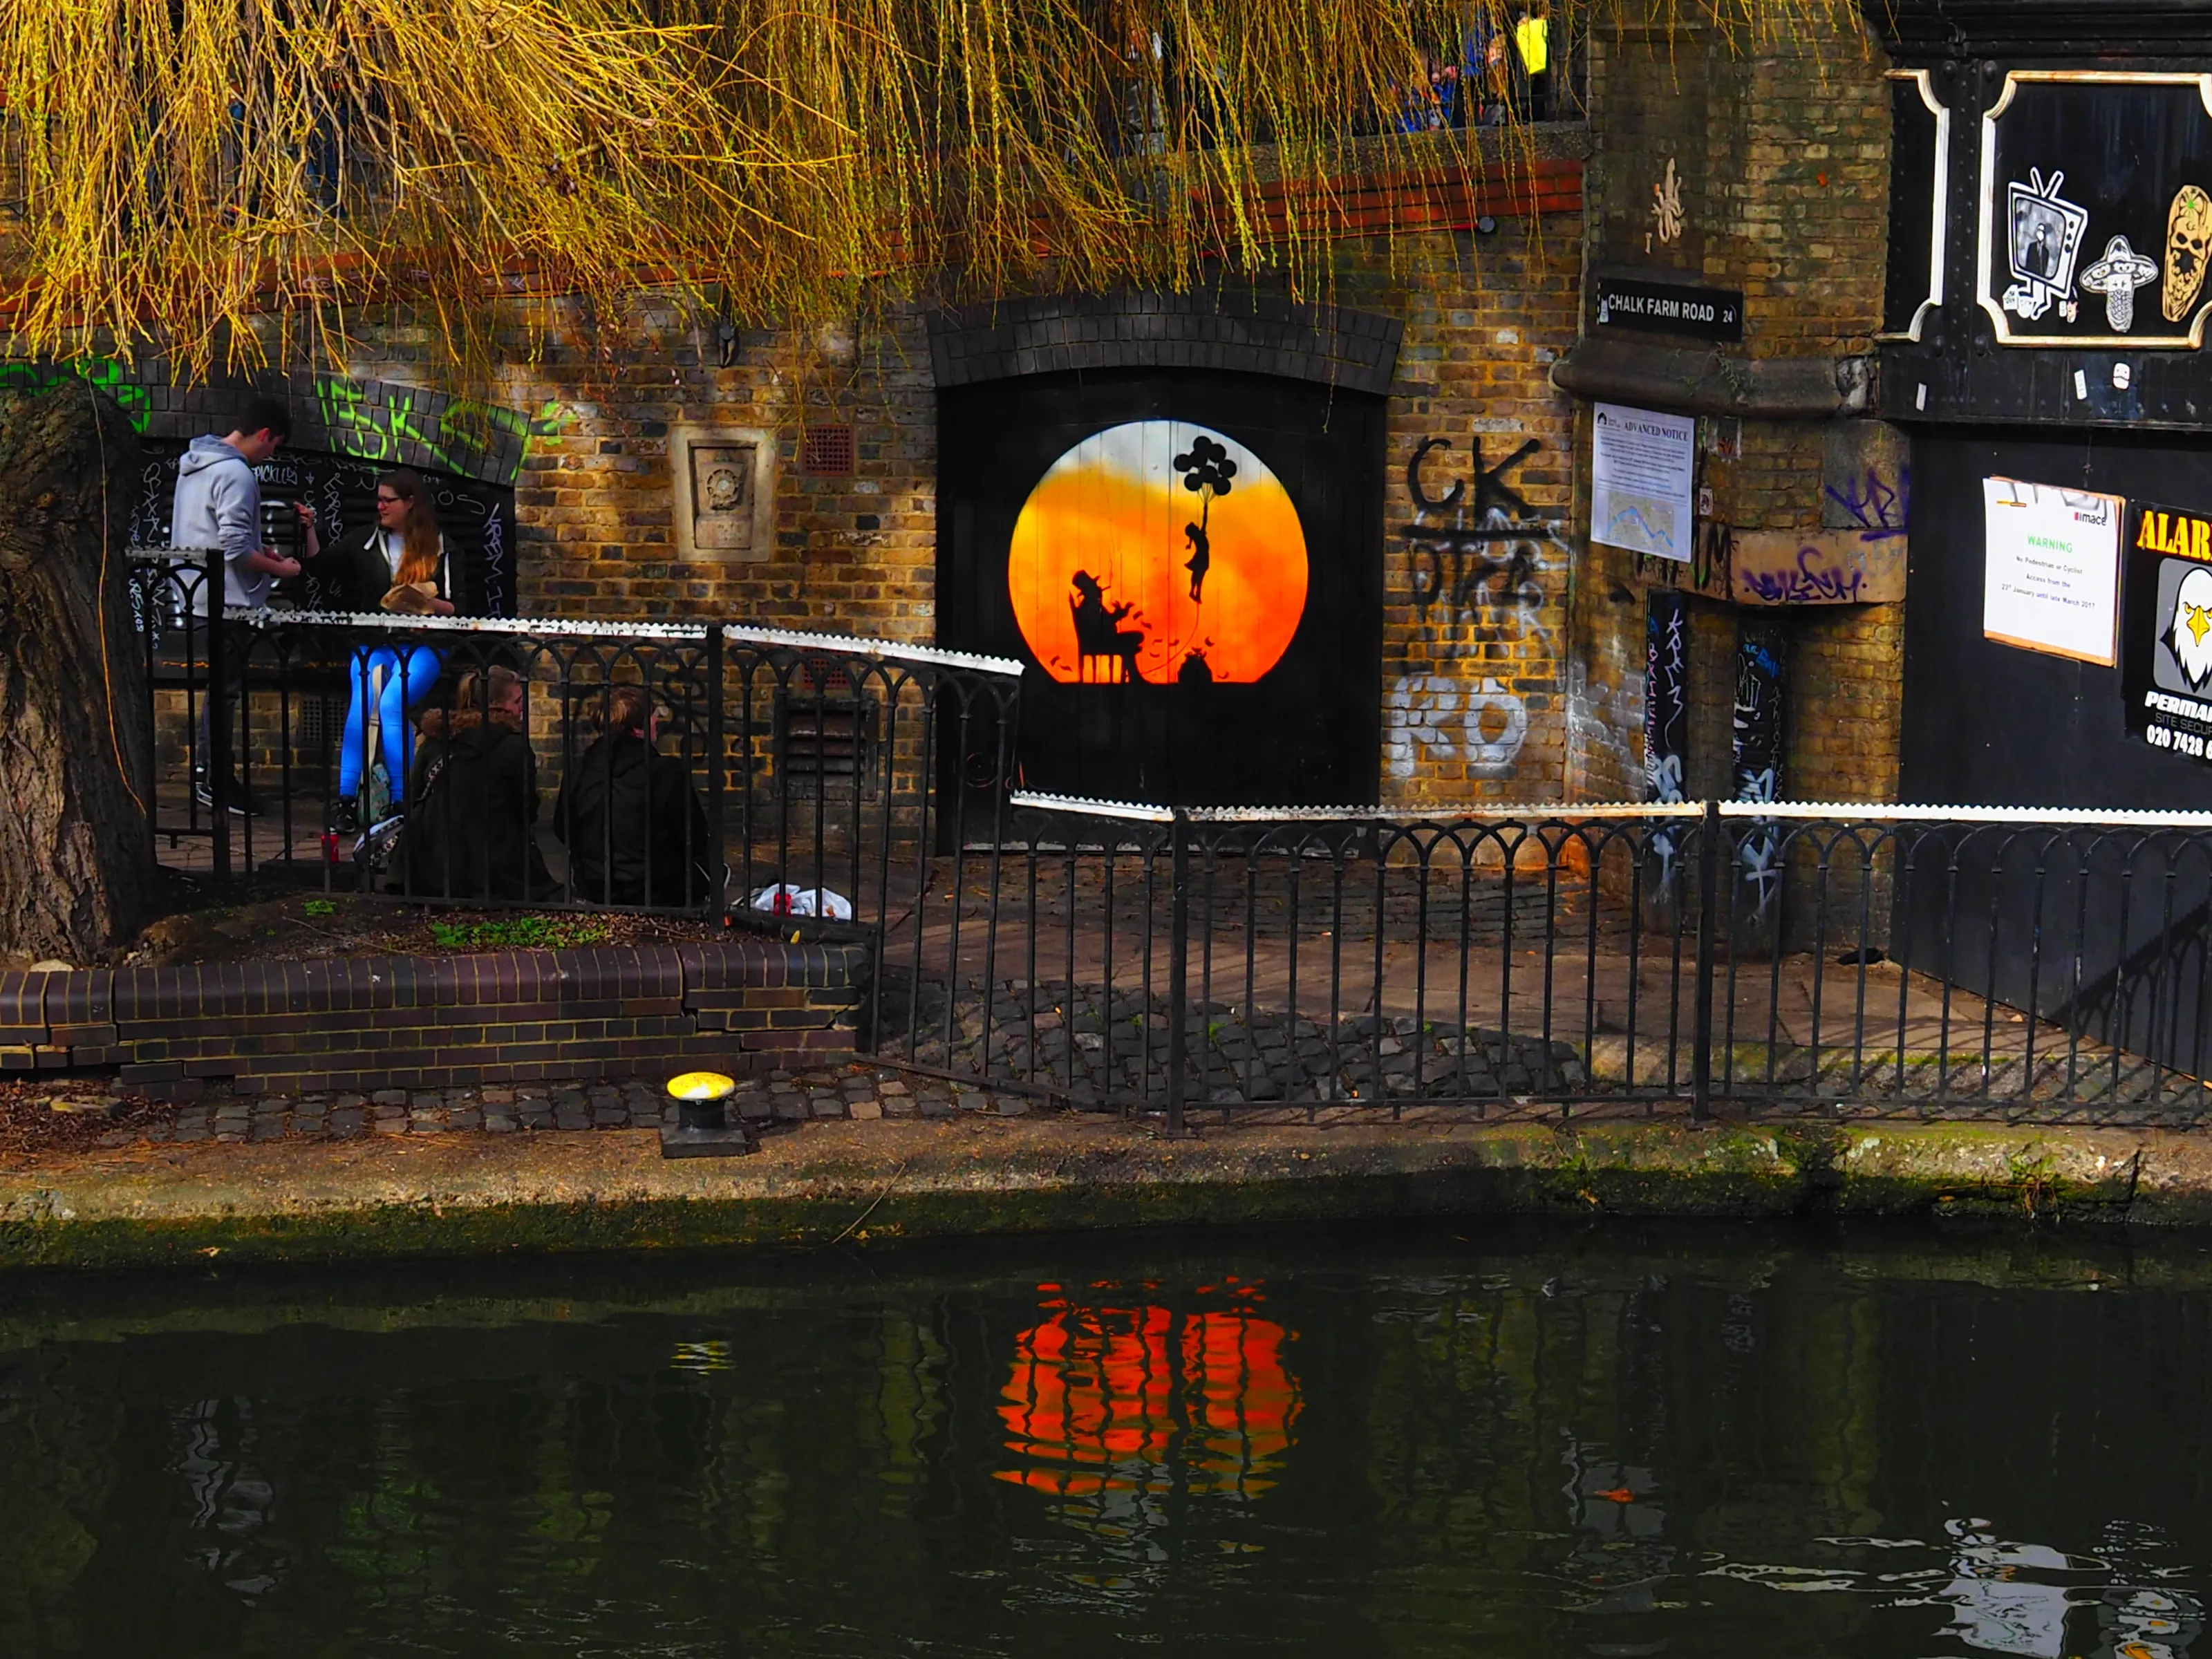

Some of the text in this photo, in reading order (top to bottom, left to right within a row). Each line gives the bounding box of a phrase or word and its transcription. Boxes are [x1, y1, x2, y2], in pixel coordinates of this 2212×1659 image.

[1609, 294, 1733, 323] CHALK FARM ROAD 24
[1624, 422, 1660, 436] ADVANCED
[1661, 428, 1688, 442] NOTICE
[2027, 534, 2072, 554] WARNING
[2137, 510, 2212, 561] ALAR
[2025, 556, 2054, 569] Pedestrian
[2026, 573, 2046, 583] Access
[2047, 578, 2060, 586] from
[2013, 586, 2034, 598] January
[2062, 597, 2080, 606] March
[2081, 600, 2096, 610] 2017
[2155, 712, 2178, 728] SITE
[2146, 724, 2171, 748] 020
[2173, 730, 2204, 757] 7428
